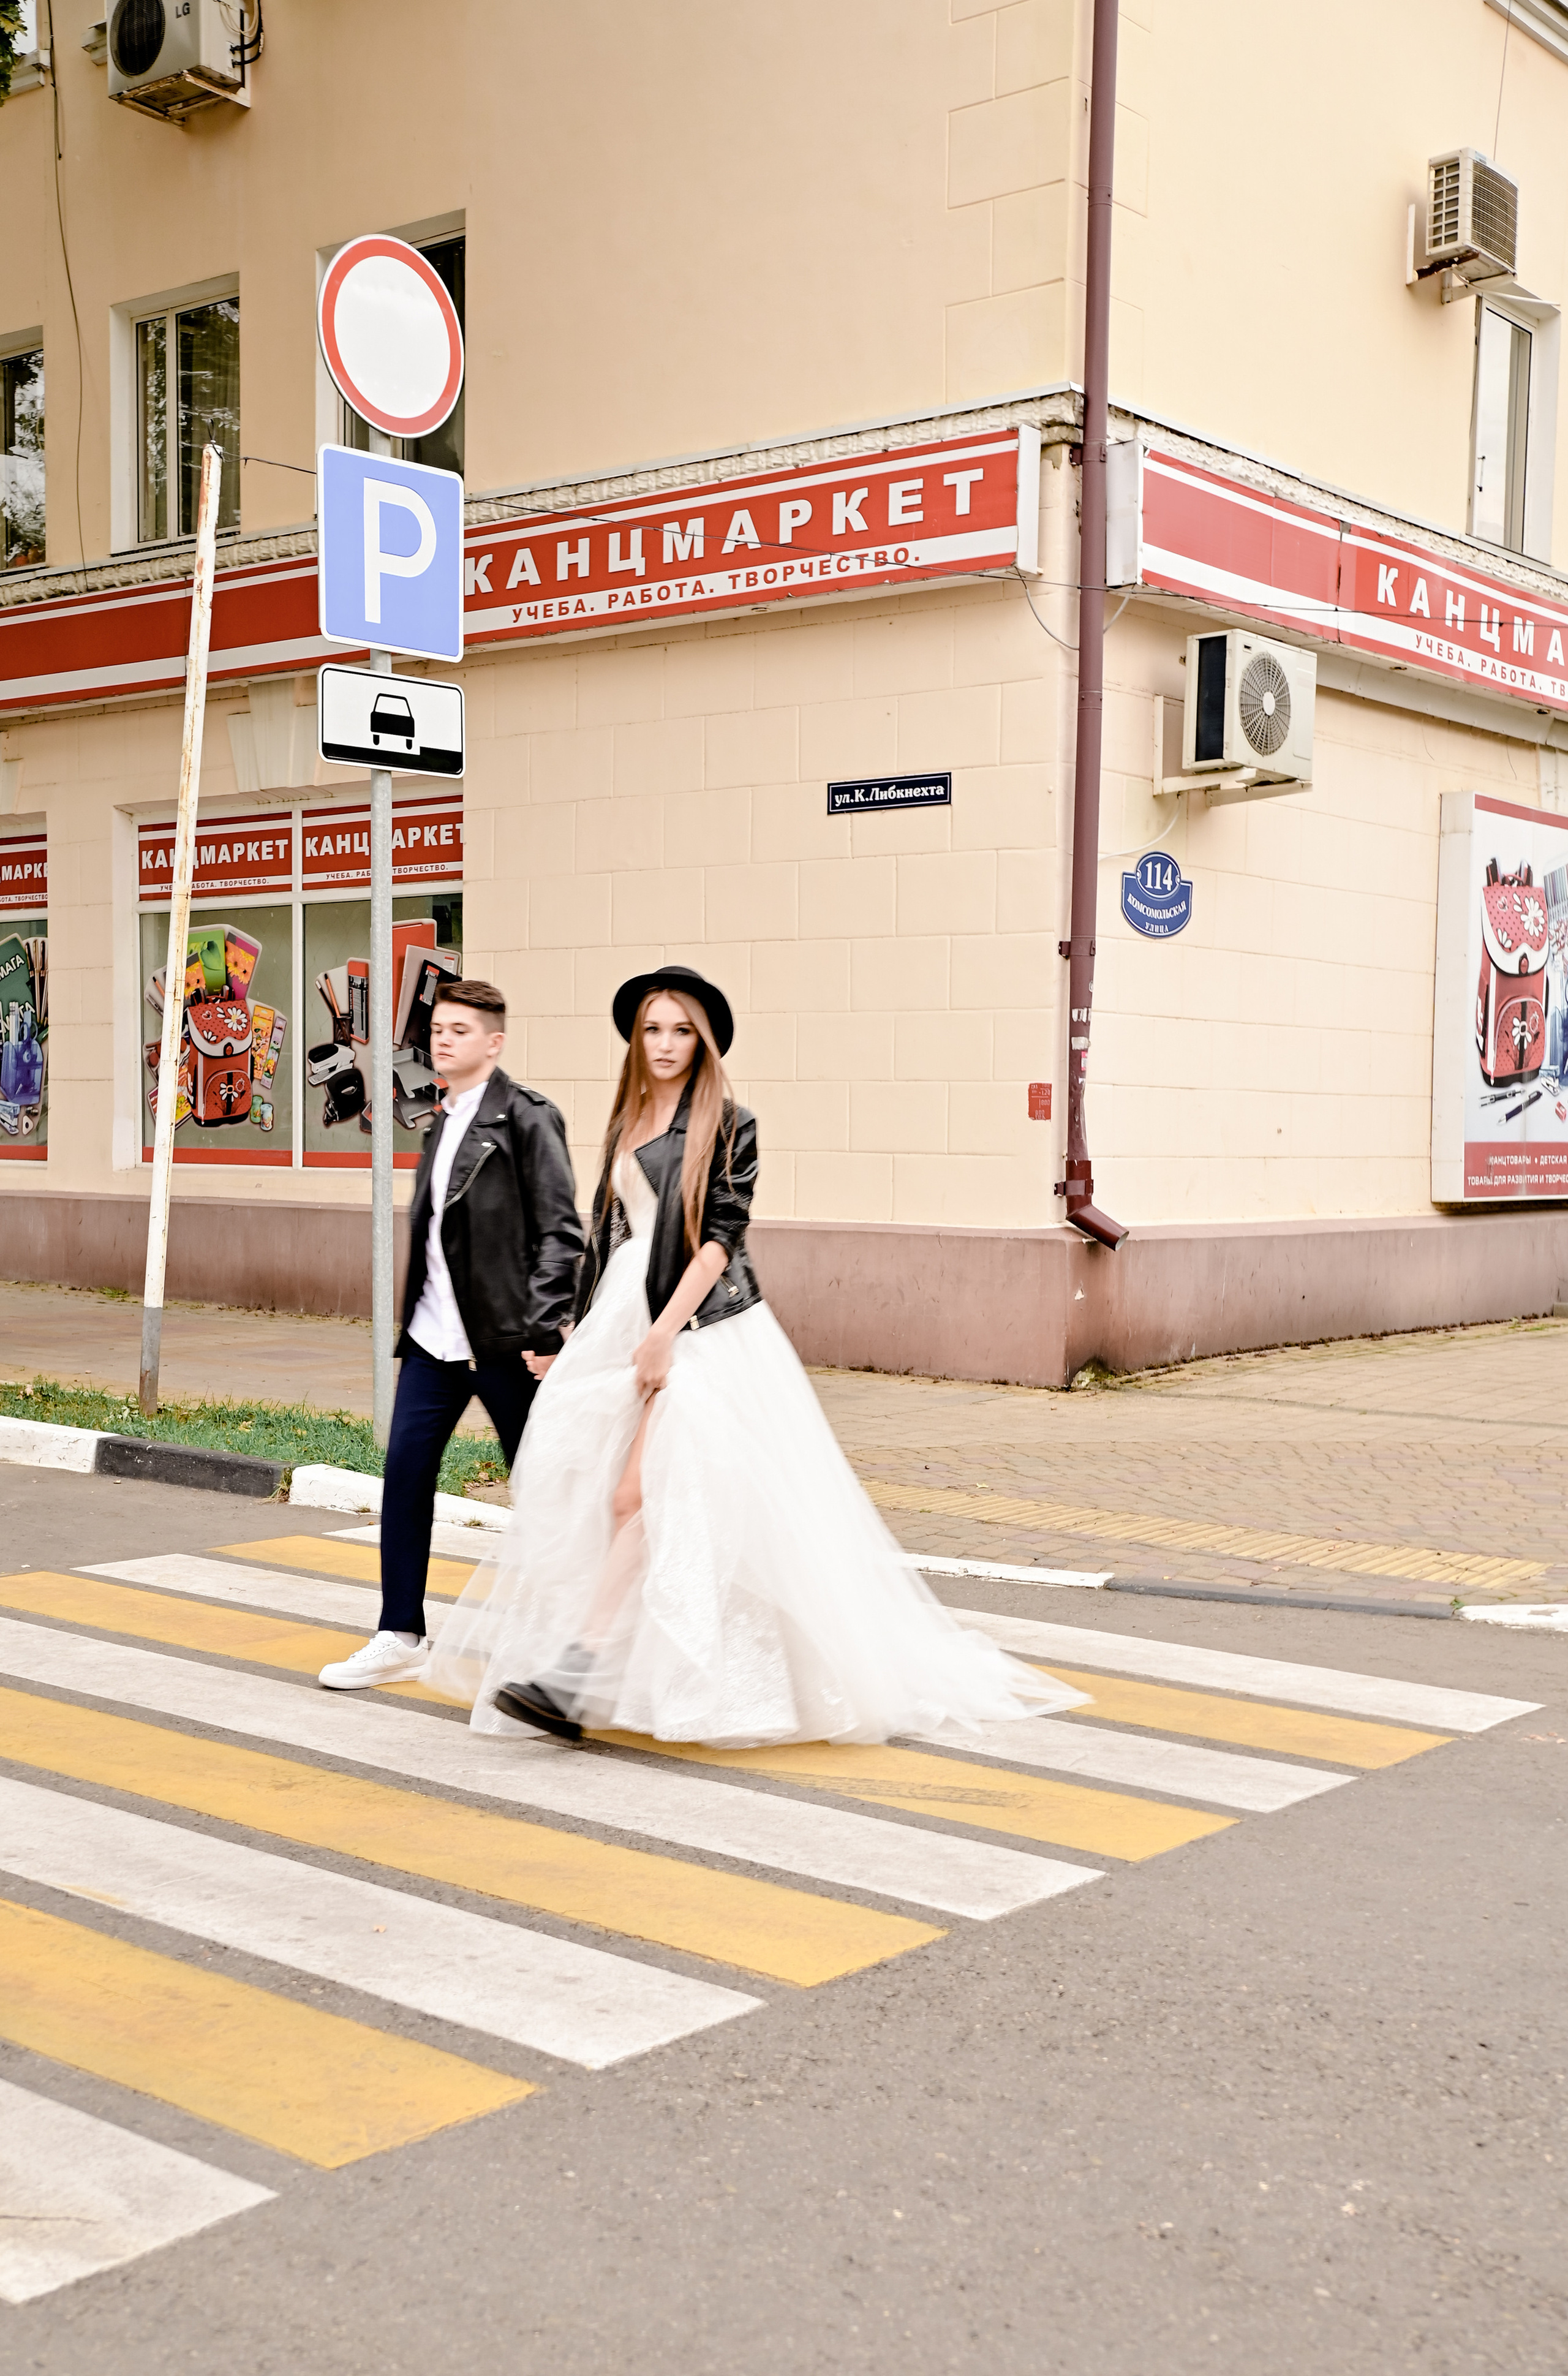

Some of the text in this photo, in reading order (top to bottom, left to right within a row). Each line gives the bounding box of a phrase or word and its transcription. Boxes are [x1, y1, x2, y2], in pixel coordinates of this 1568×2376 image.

[175, 2, 191, 19] LG
[464, 467, 984, 597] КАНЦМАРКЕТ
[512, 546, 920, 623] УЧЕБА. РАБОТА. ТВОРЧЕСТВО.
[1377, 563, 1566, 666] КАНЦМА
[1415, 634, 1471, 668] УЧЕБА.
[1480, 658, 1542, 690] РАБОТА.
[834, 785, 945, 807] ул.К.Либкнехта
[305, 822, 464, 858] КАНЦАРКЕТ
[0, 862, 48, 883] МАРКЕ
[220, 878, 270, 887] ТВОРЧЕСТВО.
[326, 872, 353, 880] УЧЕБА.
[393, 864, 449, 875] ТВОРЧЕСТВО.
[1144, 861, 1173, 891] 114
[1127, 892, 1187, 919] КОМСОМОЛЬСКАЯ
[1145, 921, 1169, 933] УЛИЦА
[1540, 1155, 1567, 1166] ДЕТСКАЯ
[1493, 1175, 1506, 1186] ДЛЯ
[1507, 1174, 1539, 1185] РАЗВИТИЯ
[1539, 1174, 1544, 1183] И
